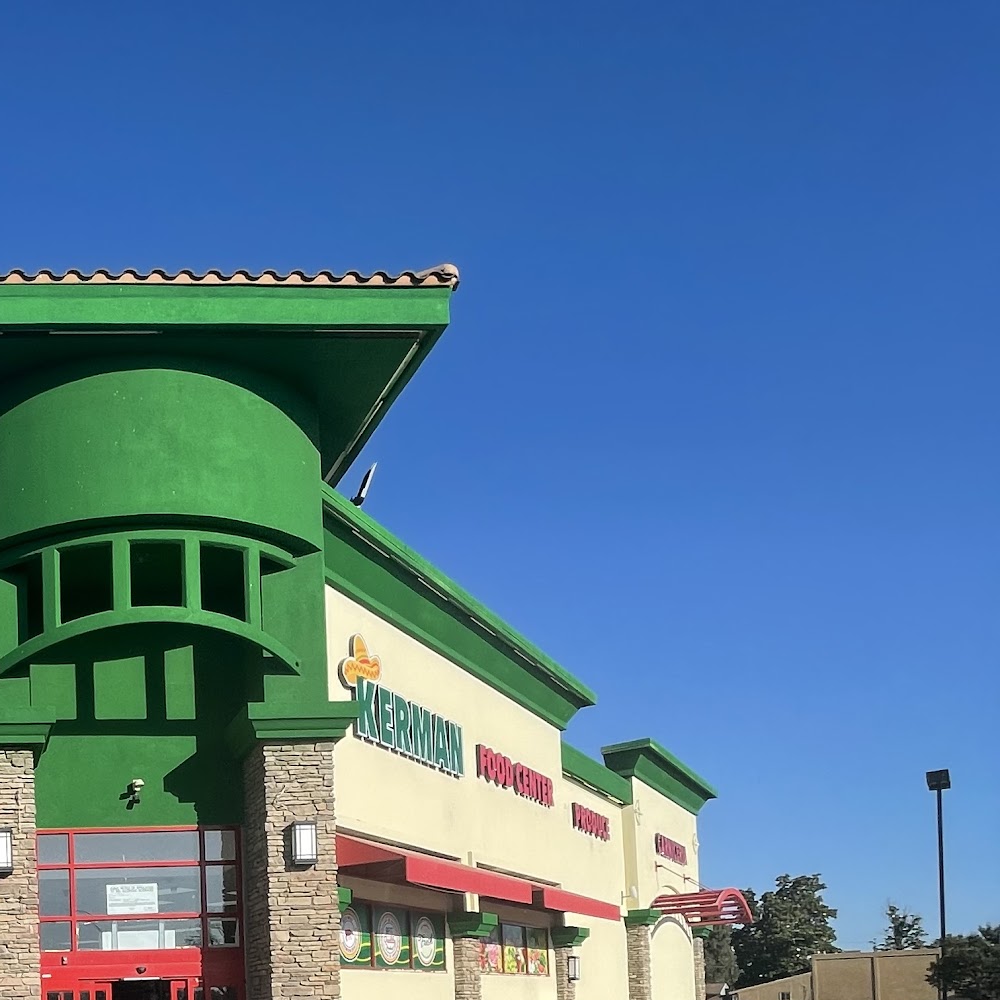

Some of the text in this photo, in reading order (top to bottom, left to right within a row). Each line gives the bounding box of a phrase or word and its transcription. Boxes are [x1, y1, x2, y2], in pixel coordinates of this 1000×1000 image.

[354, 675, 554, 808] KERMAN FOOD CENTER
[571, 802, 610, 841] PRODUCE
